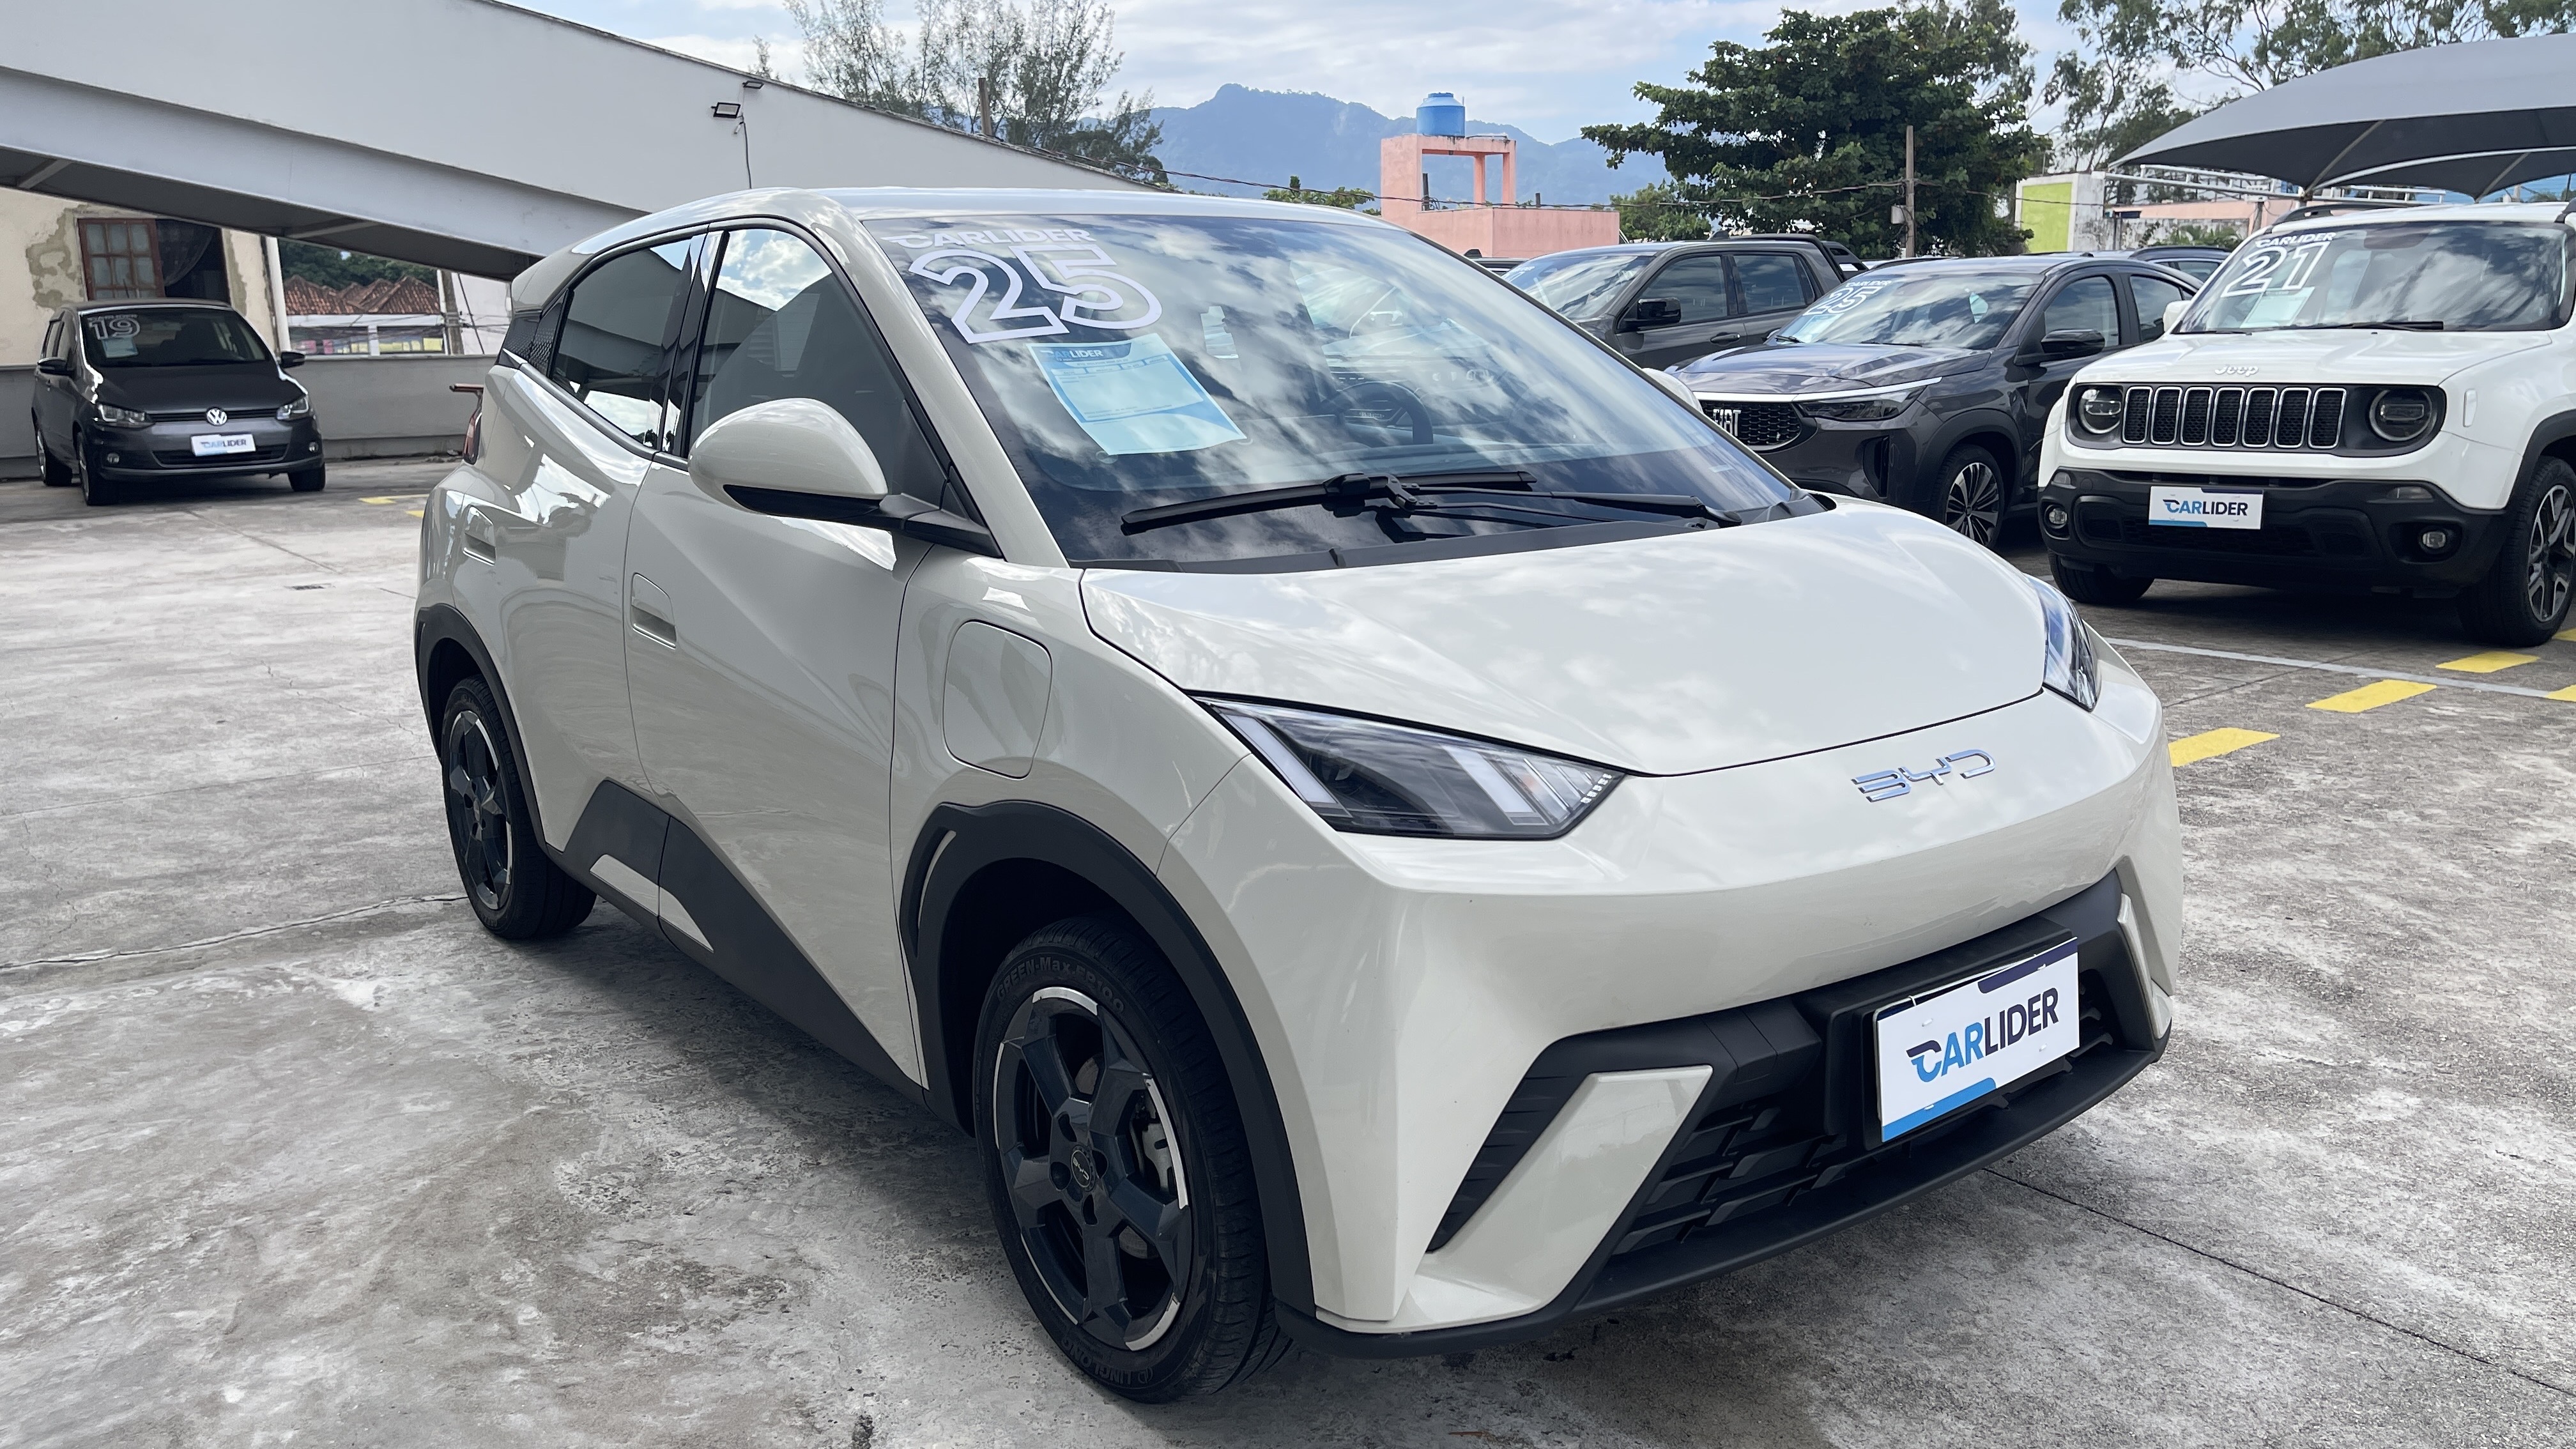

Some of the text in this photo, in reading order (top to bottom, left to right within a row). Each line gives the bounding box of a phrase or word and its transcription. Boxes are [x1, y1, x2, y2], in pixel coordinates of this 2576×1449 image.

[881, 229, 1096, 249] CARLIDER
[2255, 233, 2336, 248] CARLIDER
[2220, 241, 2331, 298] 21
[908, 244, 1162, 343] 25
[1802, 286, 1884, 316] 25
[89, 318, 140, 340] 19
[2214, 364, 2259, 377] Jeep
[2163, 499, 2249, 516] CARLIDER
[1851, 749, 1996, 802] BYD
[1906, 987, 2059, 1082] CARLIDER
